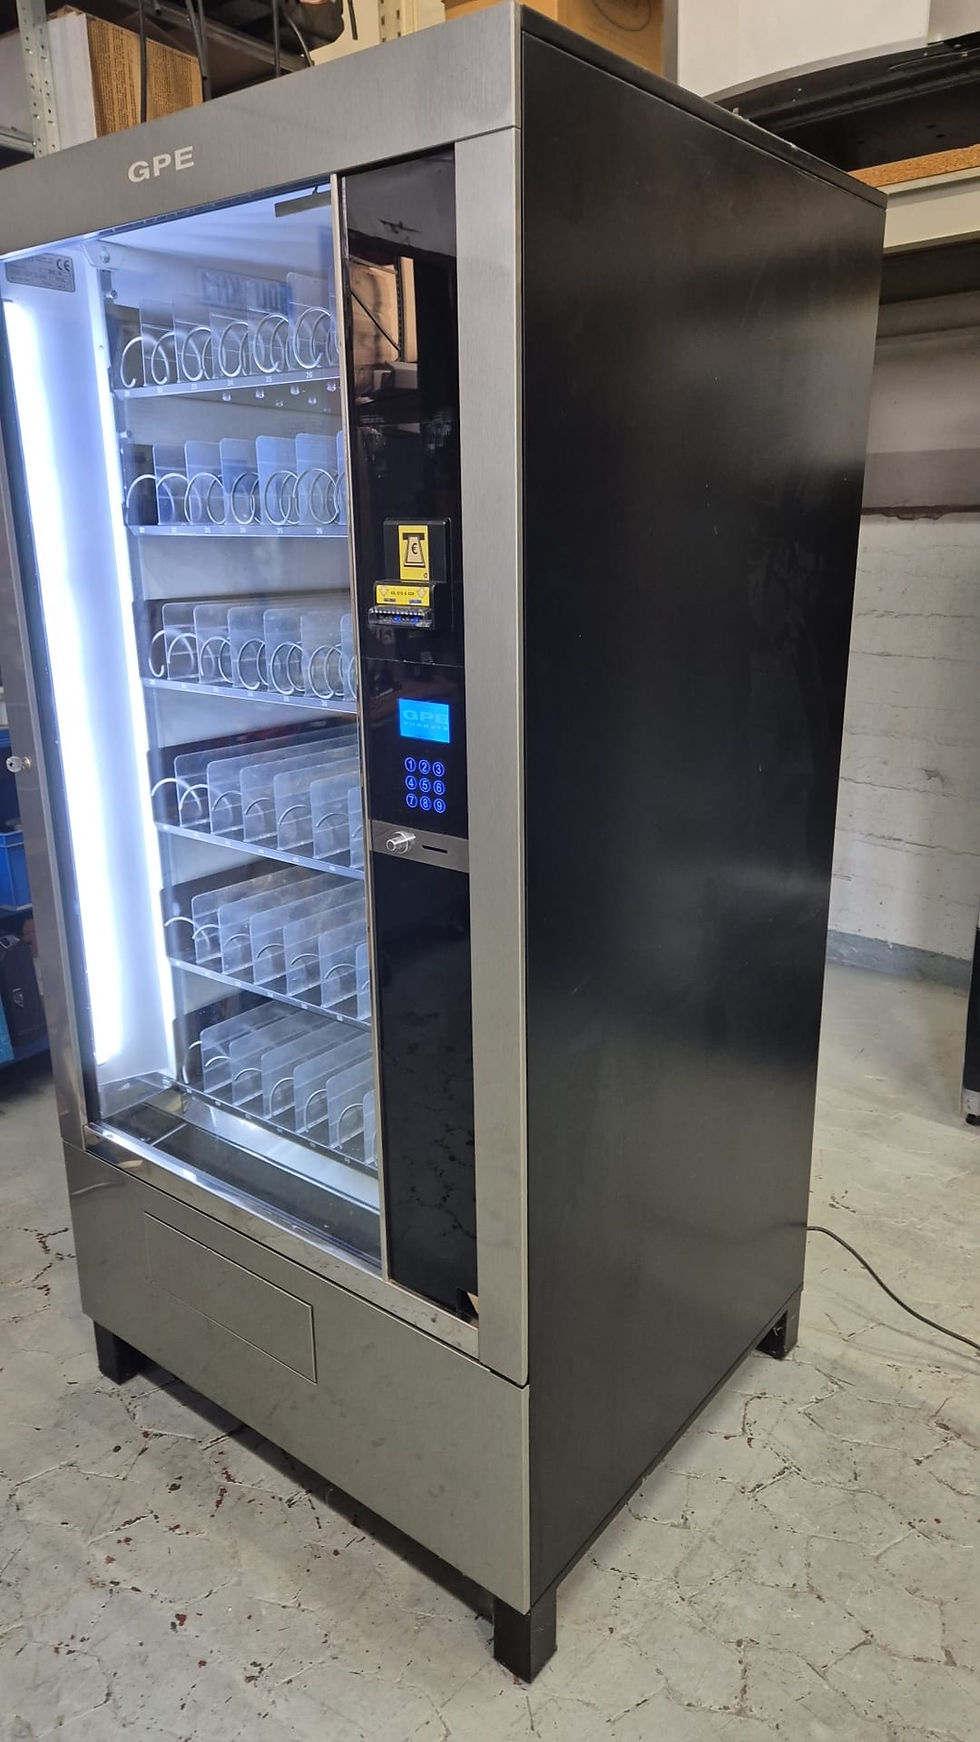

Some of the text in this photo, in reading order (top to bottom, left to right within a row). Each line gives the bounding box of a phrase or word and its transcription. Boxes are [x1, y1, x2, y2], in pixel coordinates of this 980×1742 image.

[128, 146, 194, 182] GPE
[56, 258, 70, 272] CE
[402, 709, 449, 725] GPE
